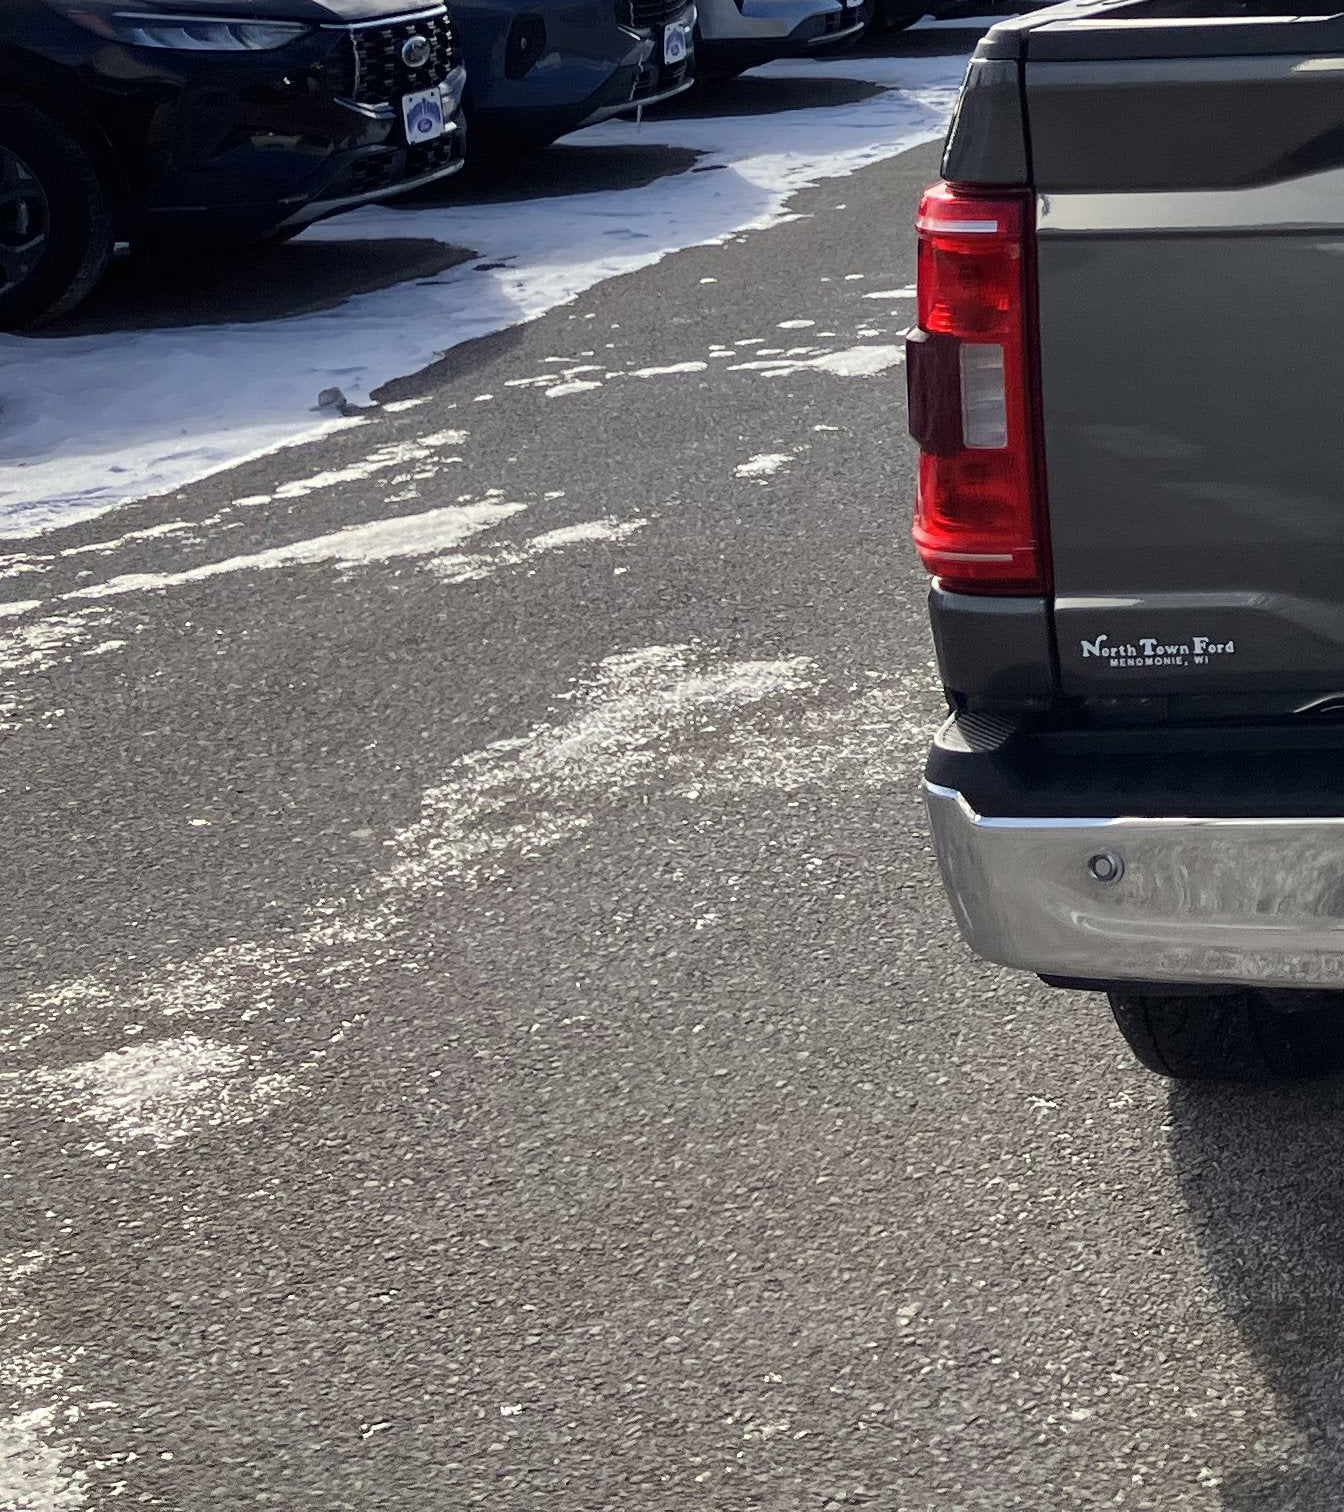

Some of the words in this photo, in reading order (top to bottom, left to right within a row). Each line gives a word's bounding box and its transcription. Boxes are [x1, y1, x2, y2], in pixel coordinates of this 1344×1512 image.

[1080, 634, 1137, 658] North
[1139, 638, 1190, 657] Town
[1192, 636, 1235, 655] Ford
[1194, 656, 1209, 665] WI
